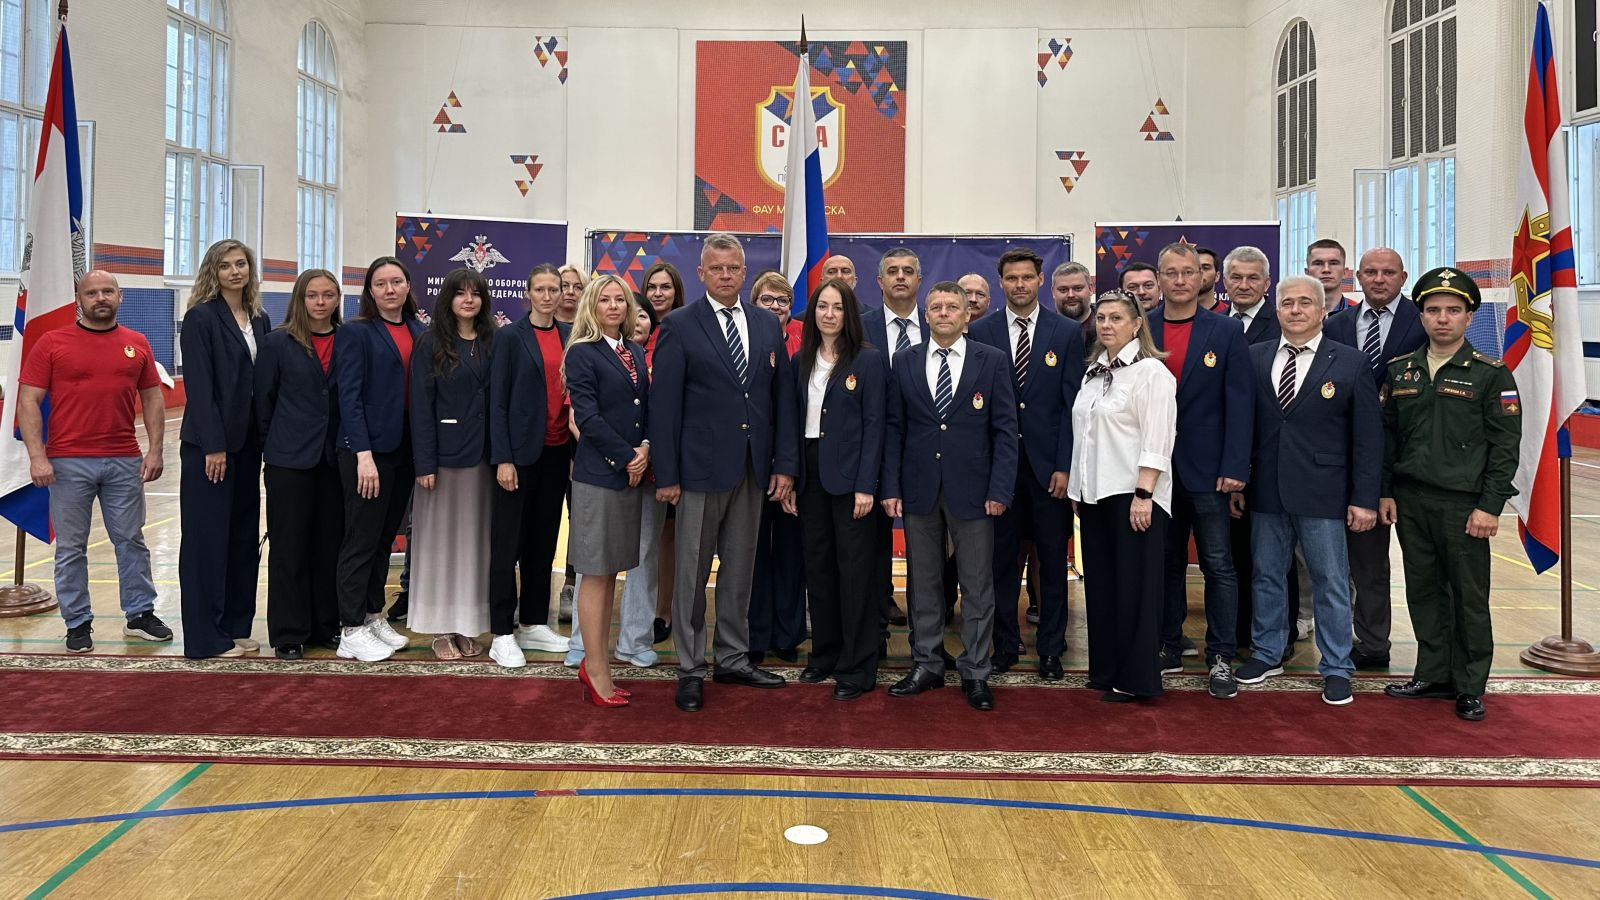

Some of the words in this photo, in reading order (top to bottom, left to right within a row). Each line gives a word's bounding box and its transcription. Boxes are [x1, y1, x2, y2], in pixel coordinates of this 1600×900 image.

[772, 125, 828, 147] СА
[752, 206, 774, 215] ФАУ
[495, 279, 527, 288] ОБОРОН
